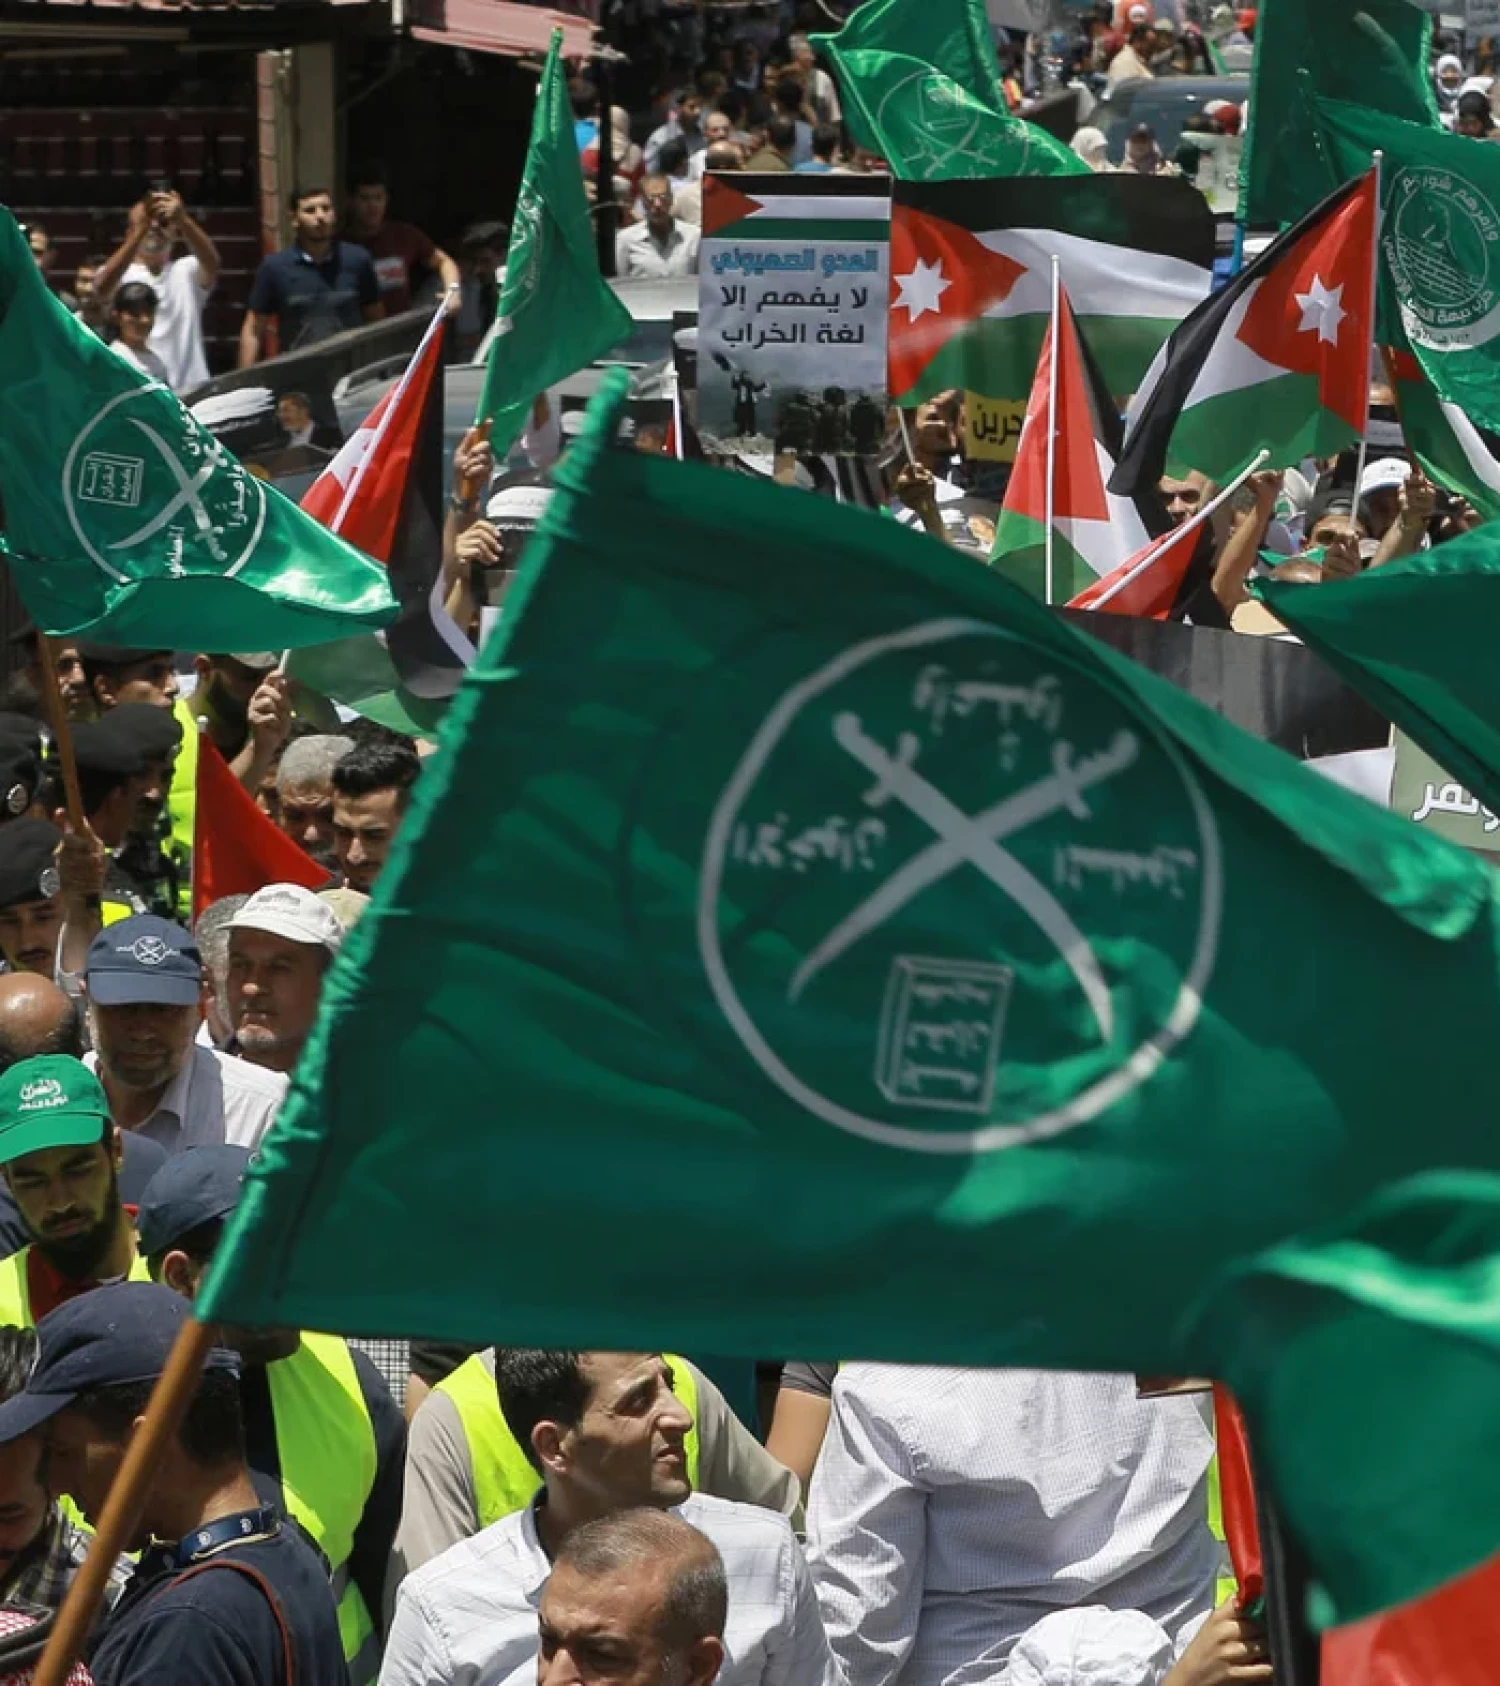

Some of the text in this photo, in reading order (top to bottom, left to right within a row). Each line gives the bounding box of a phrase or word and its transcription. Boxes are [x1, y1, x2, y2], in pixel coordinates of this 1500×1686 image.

[711, 247, 879, 278] العدو الصهيوني
[721, 285, 868, 313] لا يفهم إلا
[722, 322, 864, 349] لغة الخراب
[973, 403, 1024, 446] حرين
